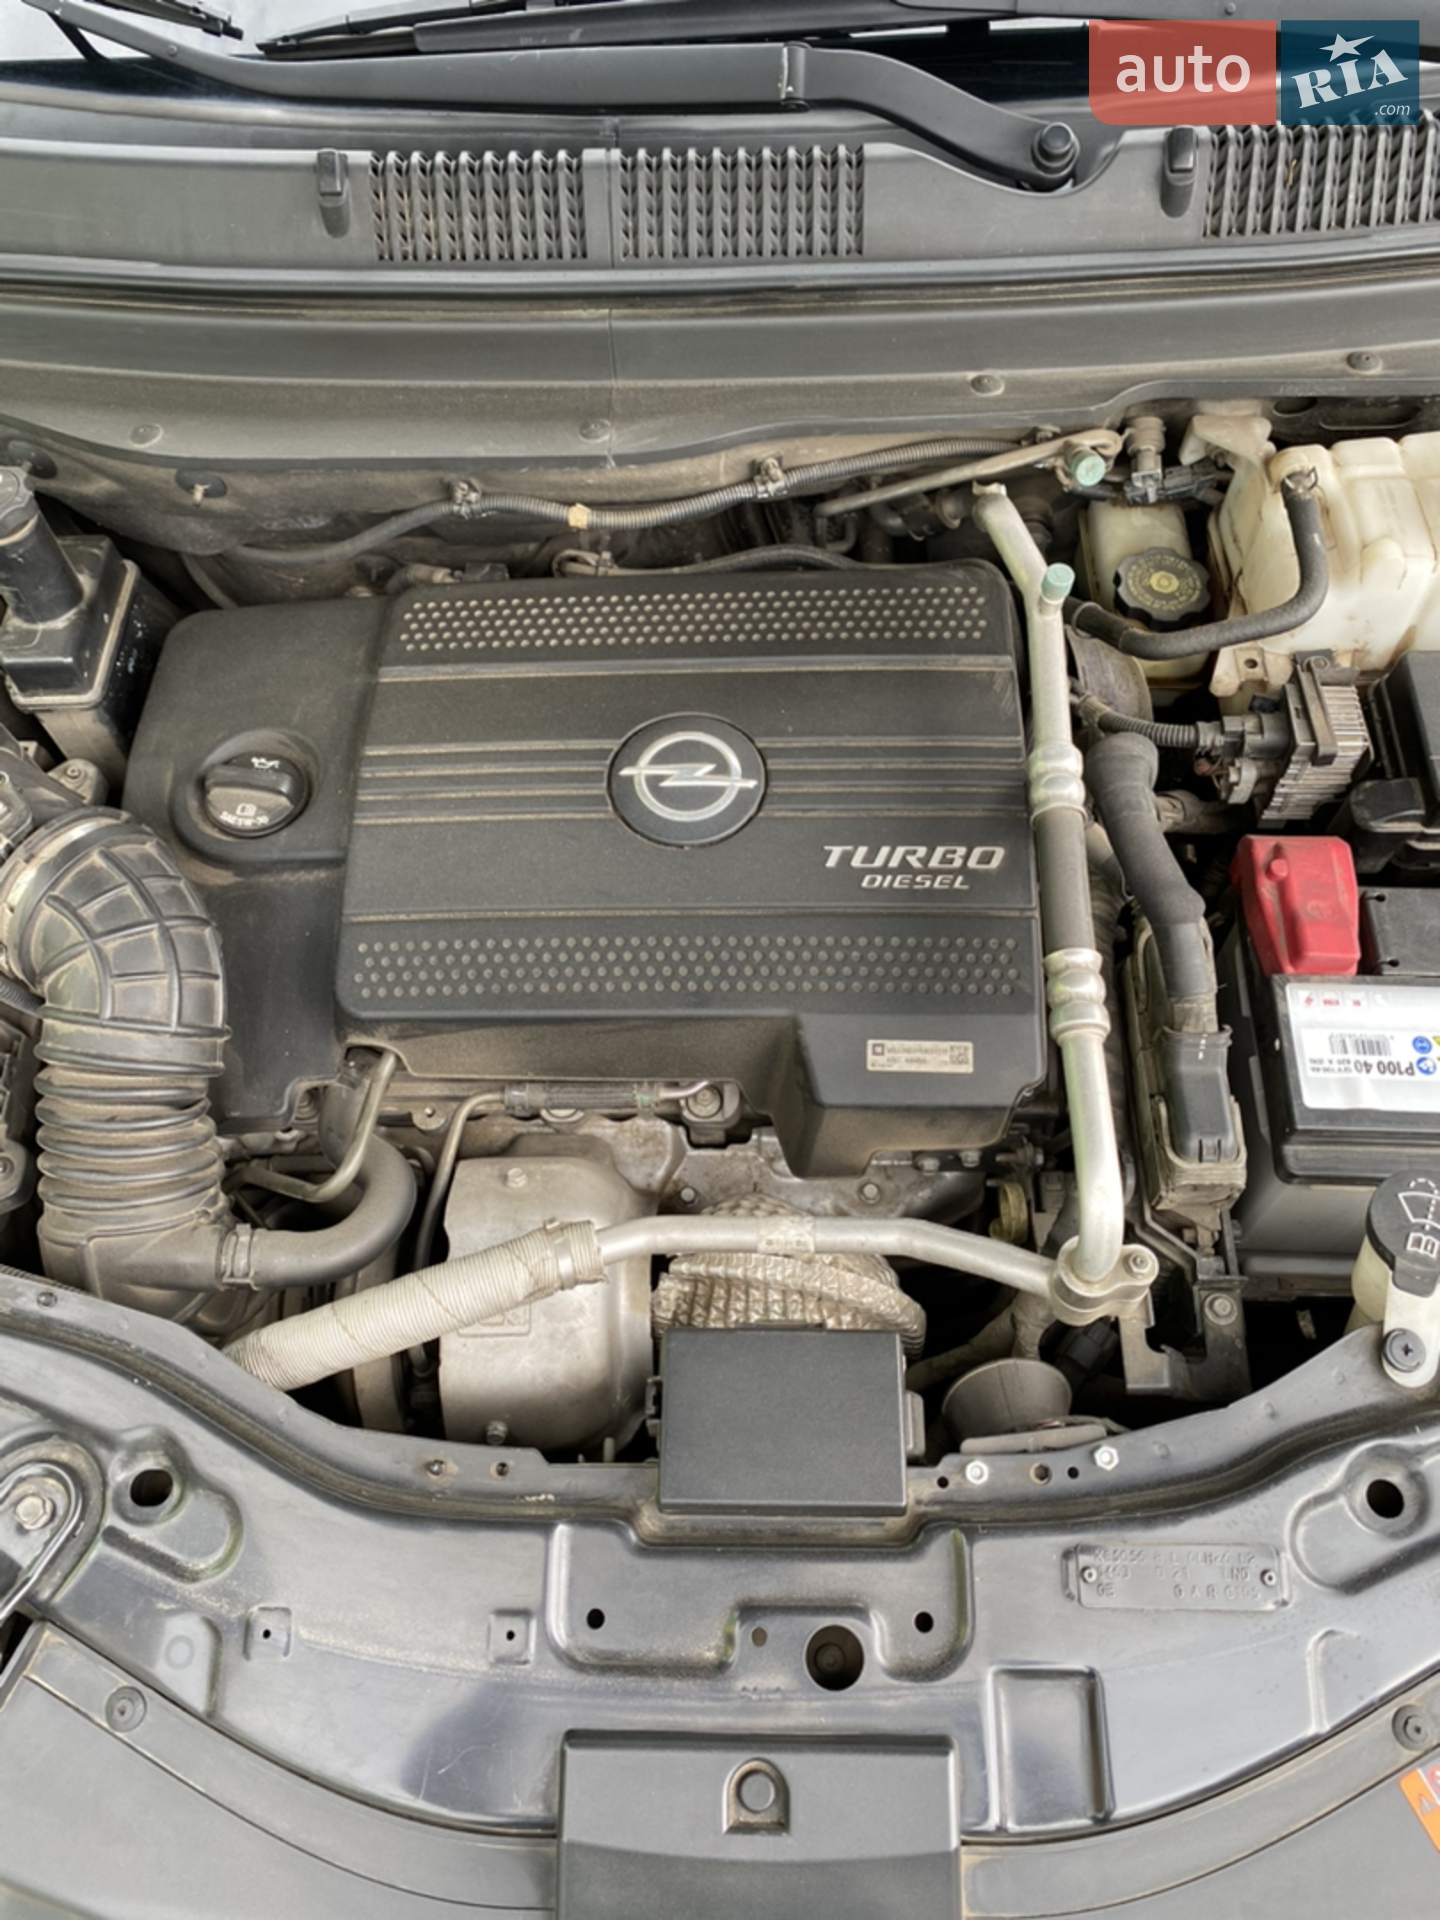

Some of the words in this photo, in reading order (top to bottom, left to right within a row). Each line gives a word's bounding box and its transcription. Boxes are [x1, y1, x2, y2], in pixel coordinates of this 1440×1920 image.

[823, 845, 1006, 869] TURBO
[860, 874, 970, 890] DIESEL
[1354, 1060, 1373, 1074] 40
[1376, 1060, 1416, 1076] P100
